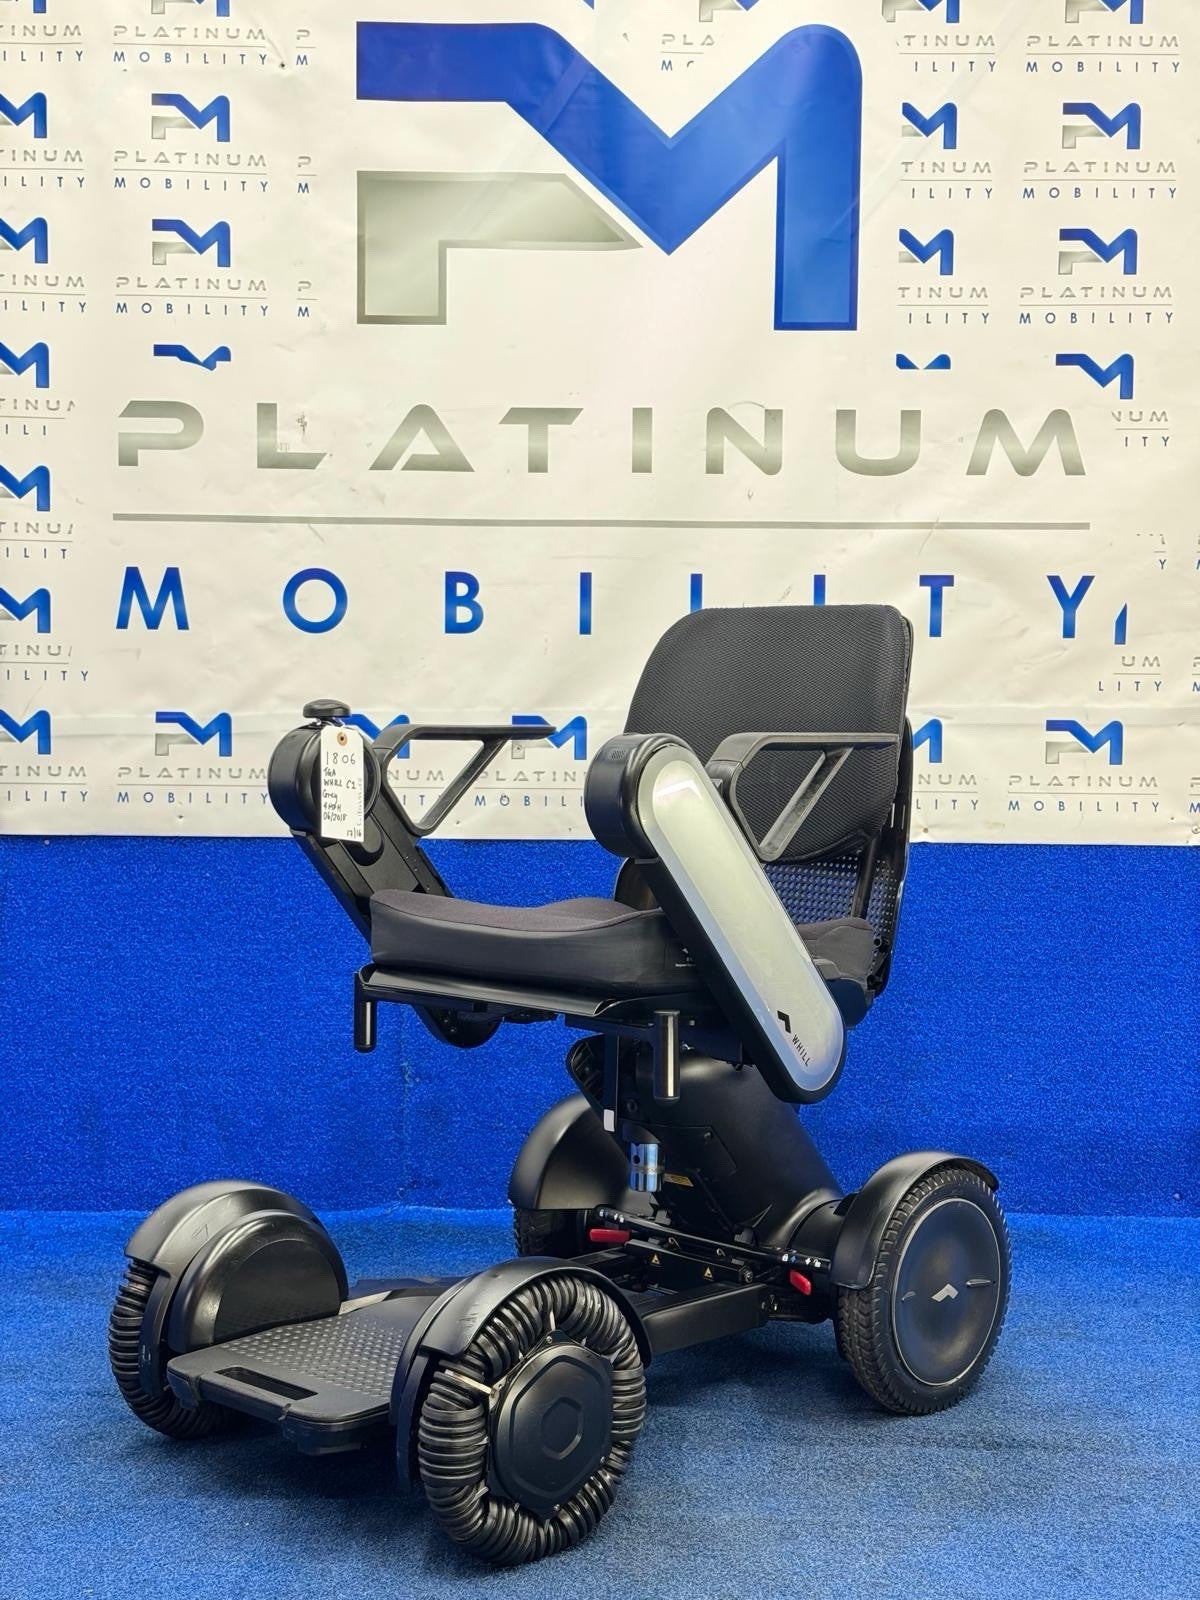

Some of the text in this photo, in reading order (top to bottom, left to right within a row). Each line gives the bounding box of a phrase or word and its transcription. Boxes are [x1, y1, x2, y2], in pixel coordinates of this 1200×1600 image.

[114, 25, 265, 40] PLATINUM
[1027, 35, 1178, 47] PLATINUM
[113, 51, 267, 65] MOBILITY
[1026, 61, 1180, 73] MOBILITY
[114, 150, 266, 167] PLATINUM
[1024, 161, 1175, 173] PLATINUM
[114, 177, 268, 192] MOBILITY
[1023, 187, 1176, 200] MOBILITY
[116, 277, 267, 291] PLATINUM
[1020, 286, 1172, 298] PLATINUM
[115, 302, 268, 317] MOBILITY
[1019, 312, 1173, 324] MOBILITY
[118, 400, 1086, 476] PLATINUM
[326, 751, 357, 765] 1806
[117, 767, 266, 779] PLATINUM
[1009, 775, 1158, 787] PLATINUM
[117, 792, 268, 804] MOBILITY
[1008, 800, 1159, 813] MOBILITY
[792, 1034, 812, 1067] WHILL
